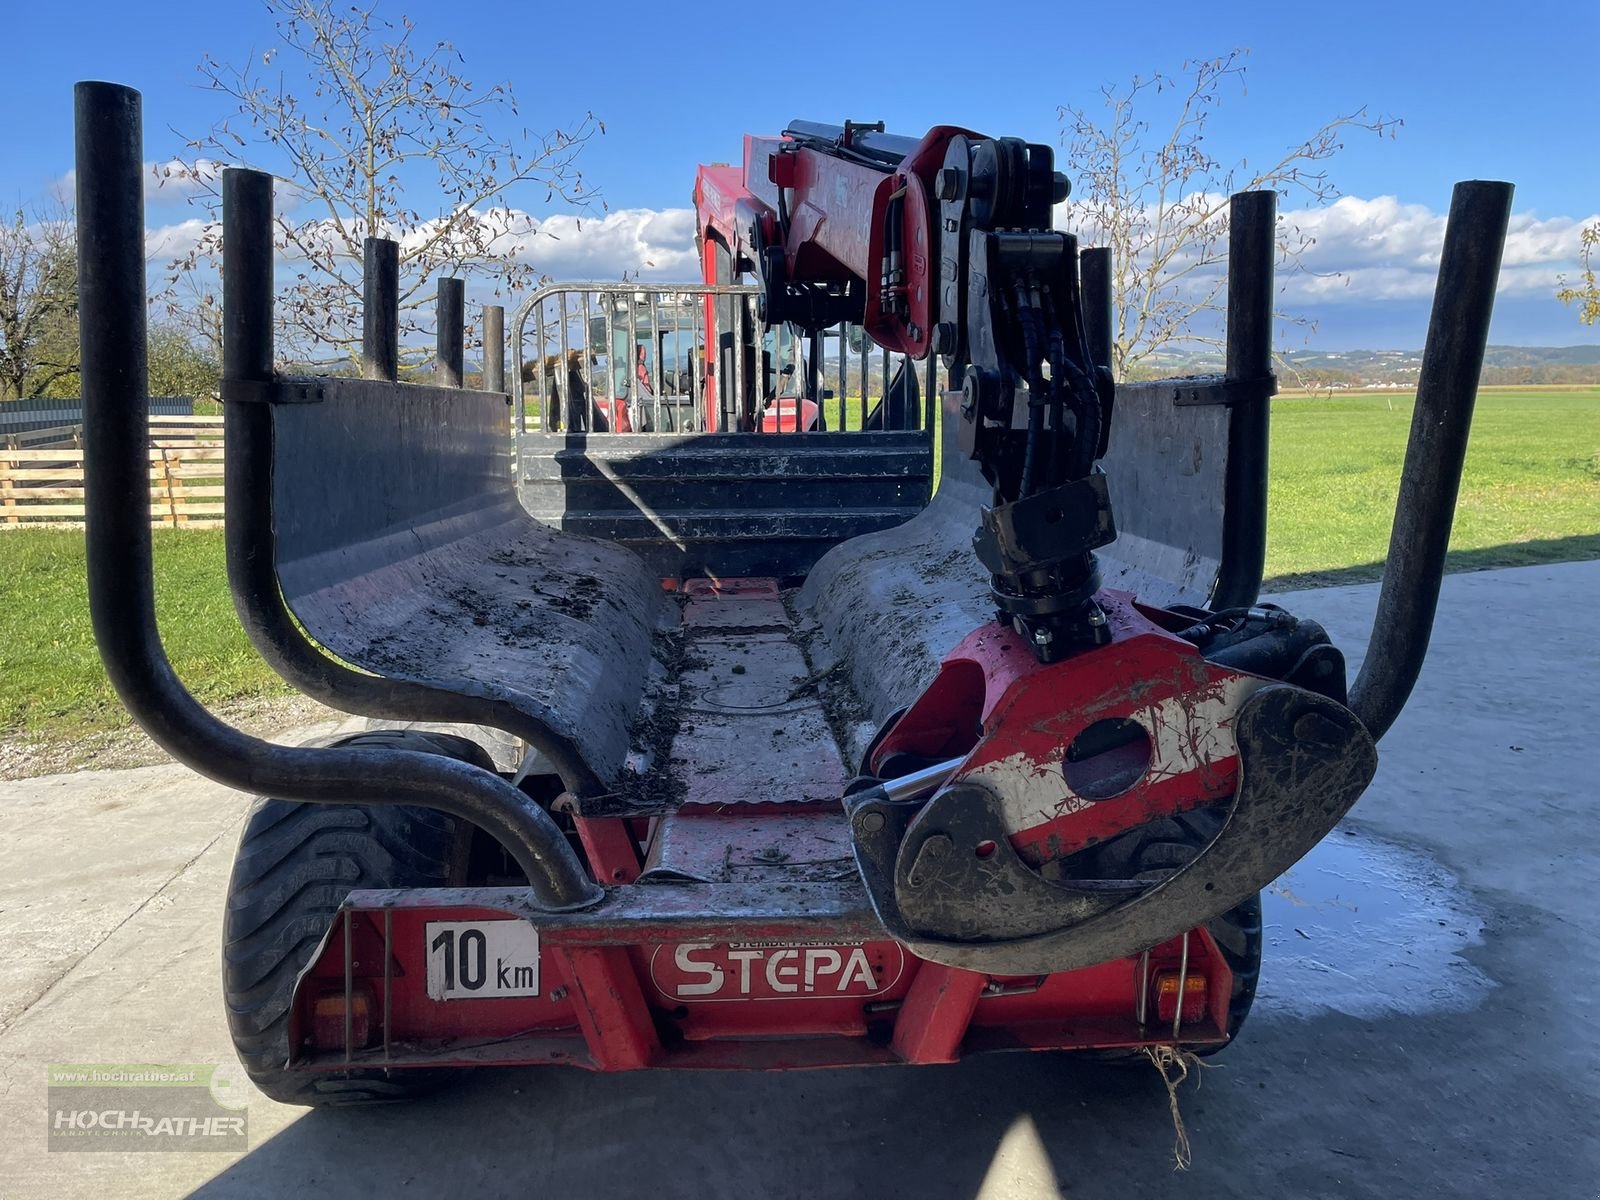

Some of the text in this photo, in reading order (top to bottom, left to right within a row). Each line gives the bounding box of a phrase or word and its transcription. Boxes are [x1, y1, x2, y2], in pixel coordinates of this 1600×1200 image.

[432, 929, 533, 990] 10 km
[675, 942, 878, 996] STEPA
